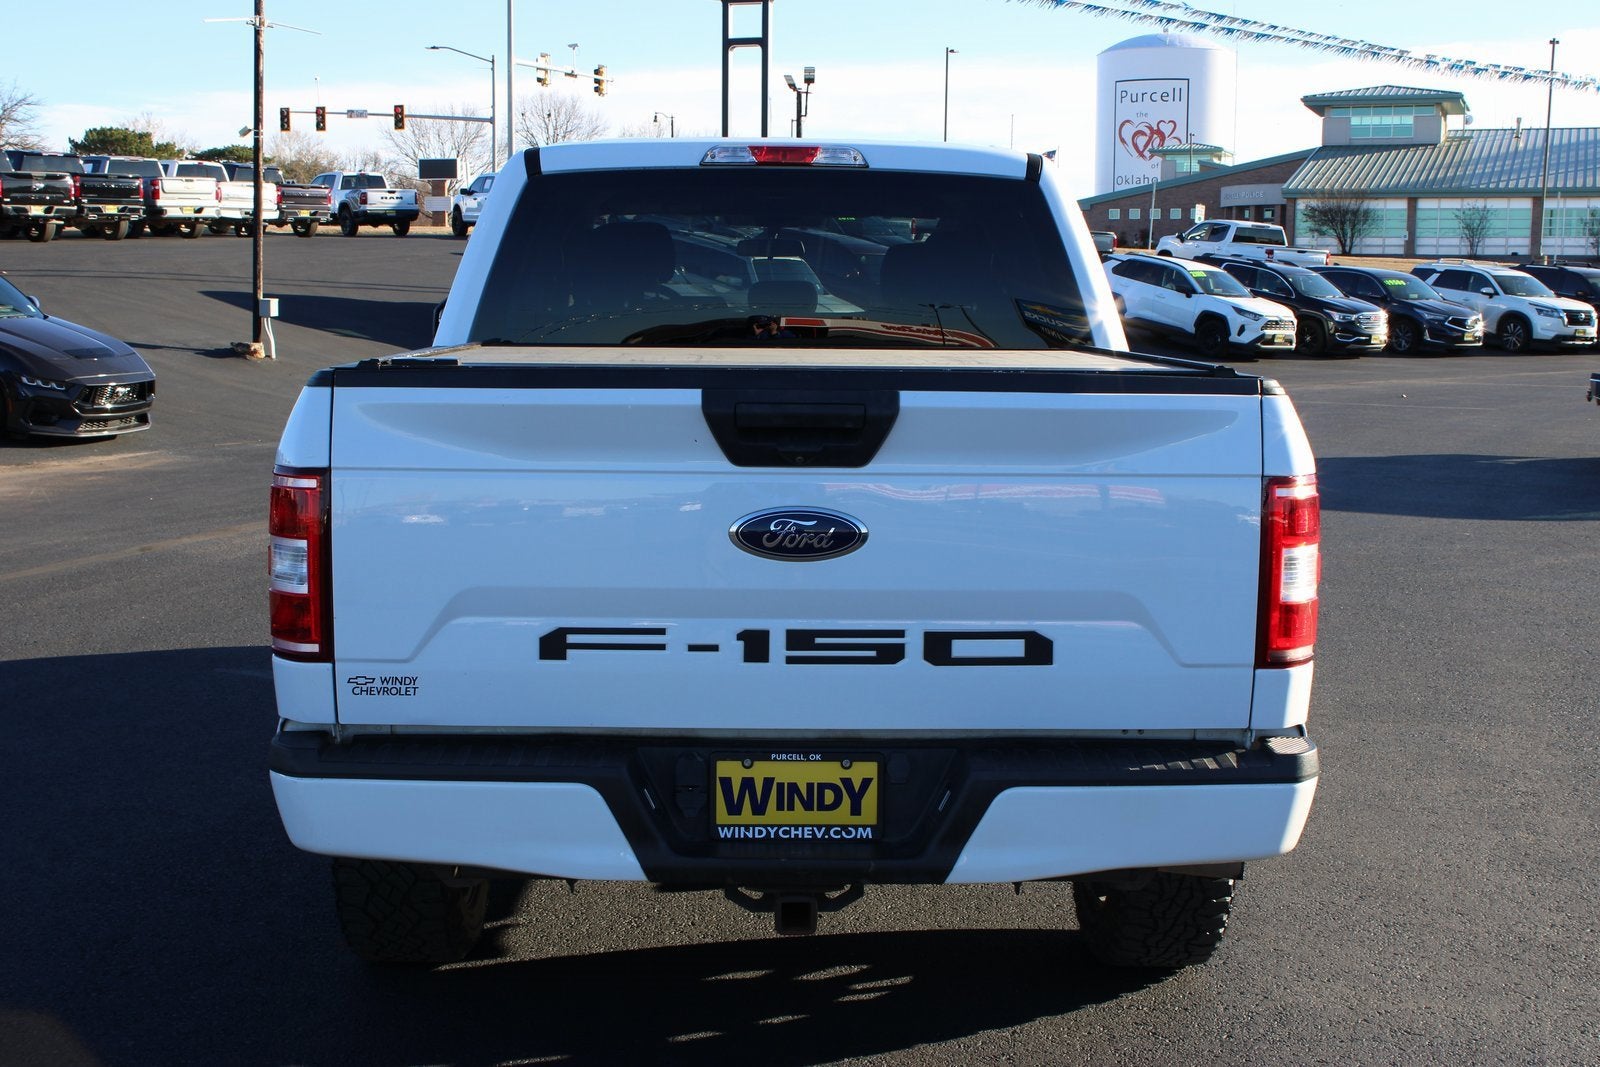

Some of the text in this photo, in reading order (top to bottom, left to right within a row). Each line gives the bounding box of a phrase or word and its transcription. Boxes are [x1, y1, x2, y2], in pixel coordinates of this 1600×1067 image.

[1120, 87, 1182, 103] Purcell
[1116, 174, 1159, 186] Oklaho
[762, 518, 835, 548] Ford
[539, 626, 1054, 667] F-150
[380, 676, 419, 686] WINDY
[351, 686, 419, 696] CHEVROLET
[771, 753, 822, 761] PURCELL, OK
[718, 776, 874, 817] WINDY
[717, 826, 873, 839] WINDYCHEV.COM
